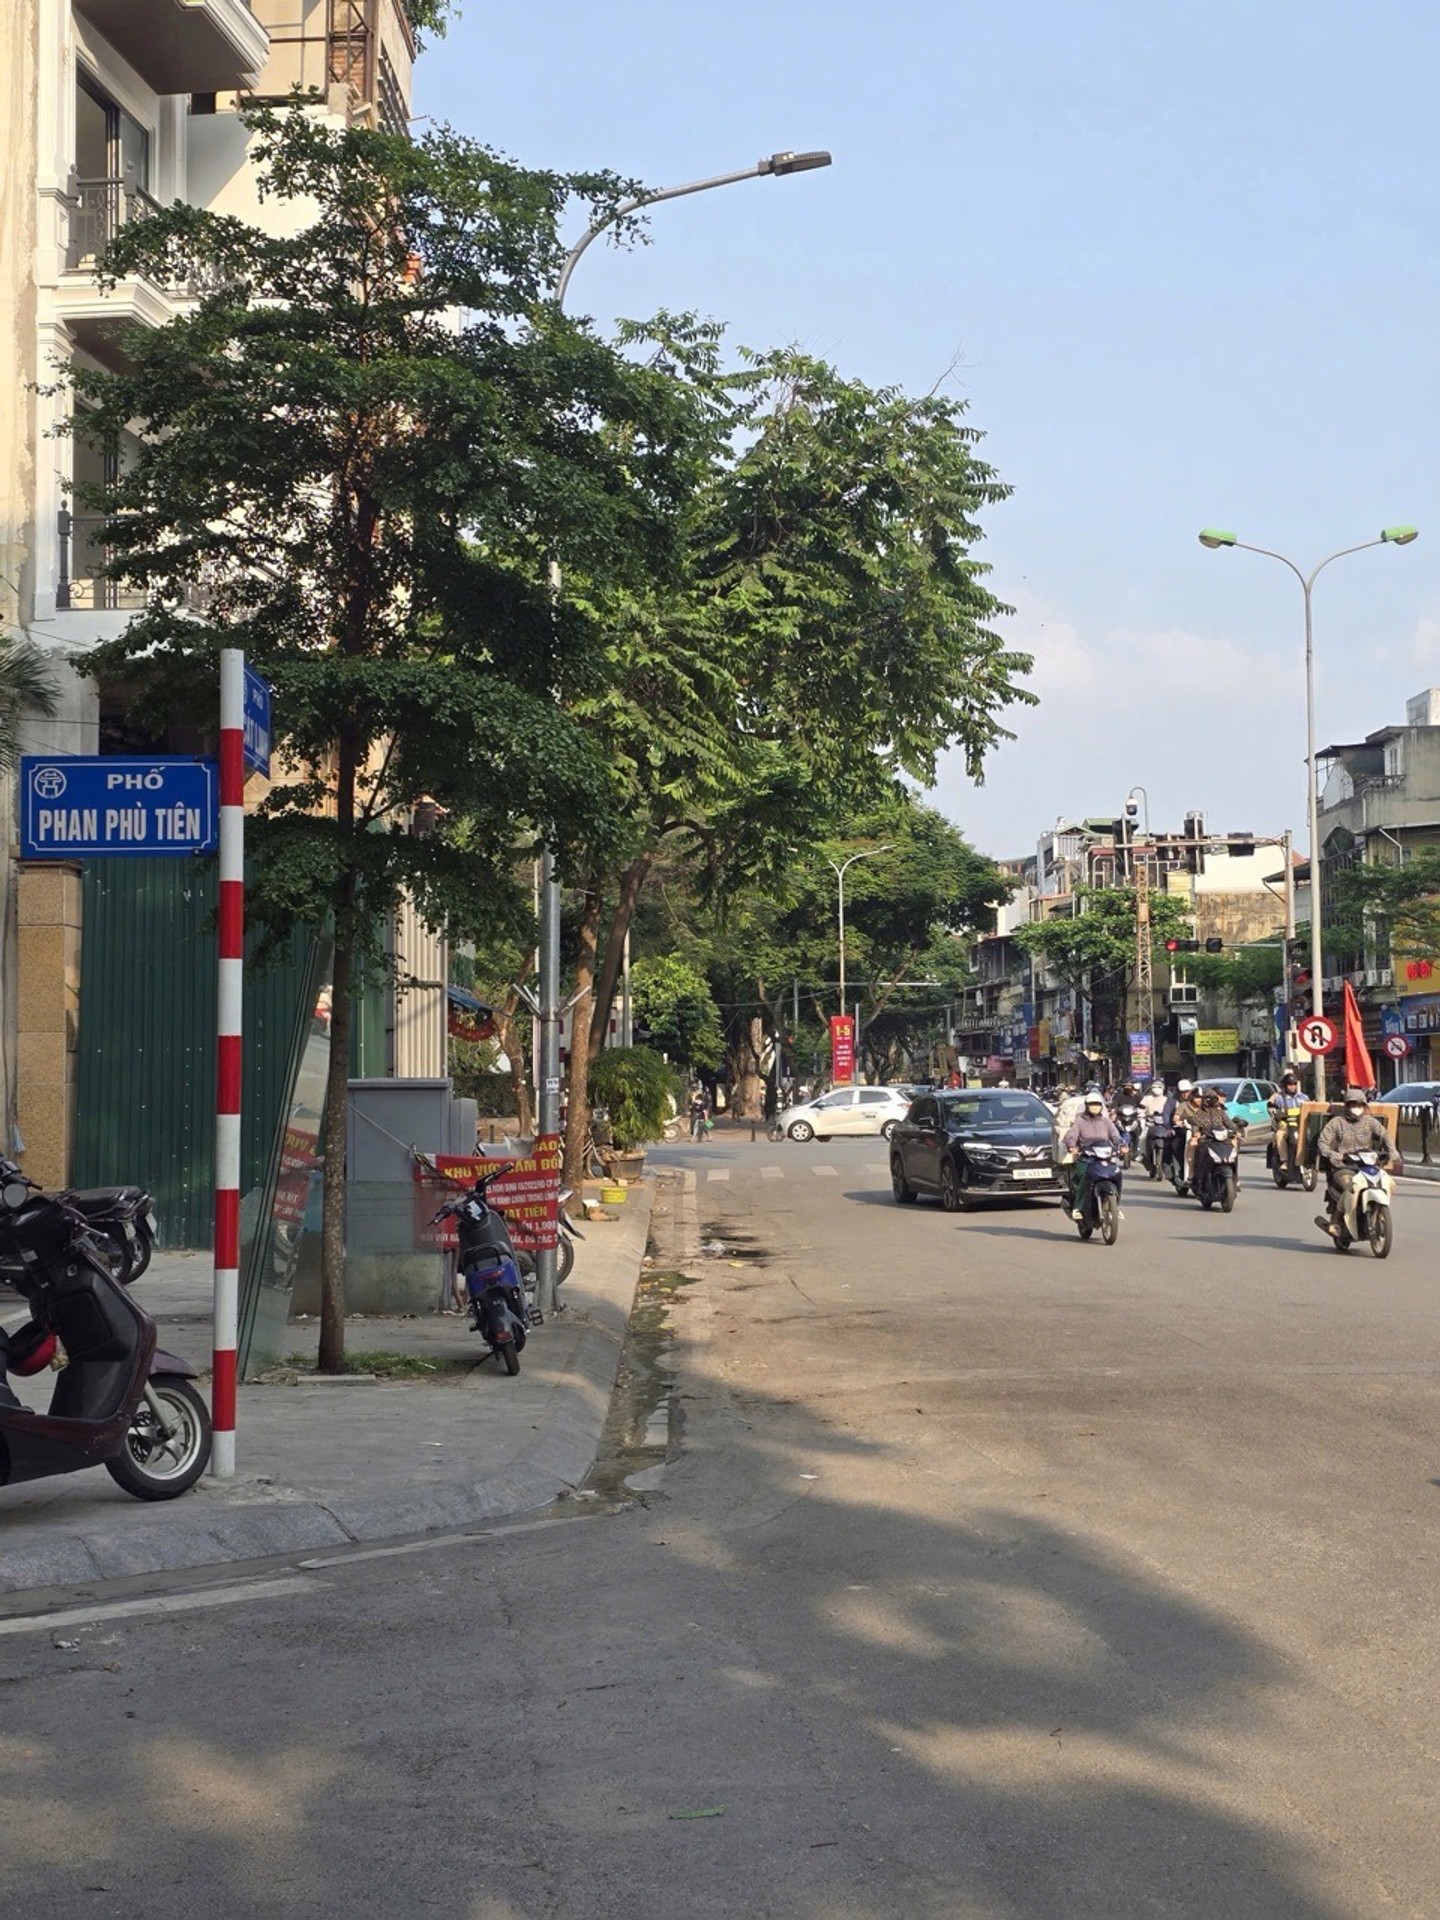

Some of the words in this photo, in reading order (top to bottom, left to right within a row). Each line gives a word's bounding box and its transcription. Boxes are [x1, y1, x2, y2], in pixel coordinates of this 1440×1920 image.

[107, 766, 166, 790] PHỐ
[38, 809, 97, 842] PHAN
[105, 801, 146, 841] PHÙ
[154, 801, 200, 841] TIÊN
[835, 1025, 850, 1036] 1-5
[443, 1165, 471, 1179] KHU
